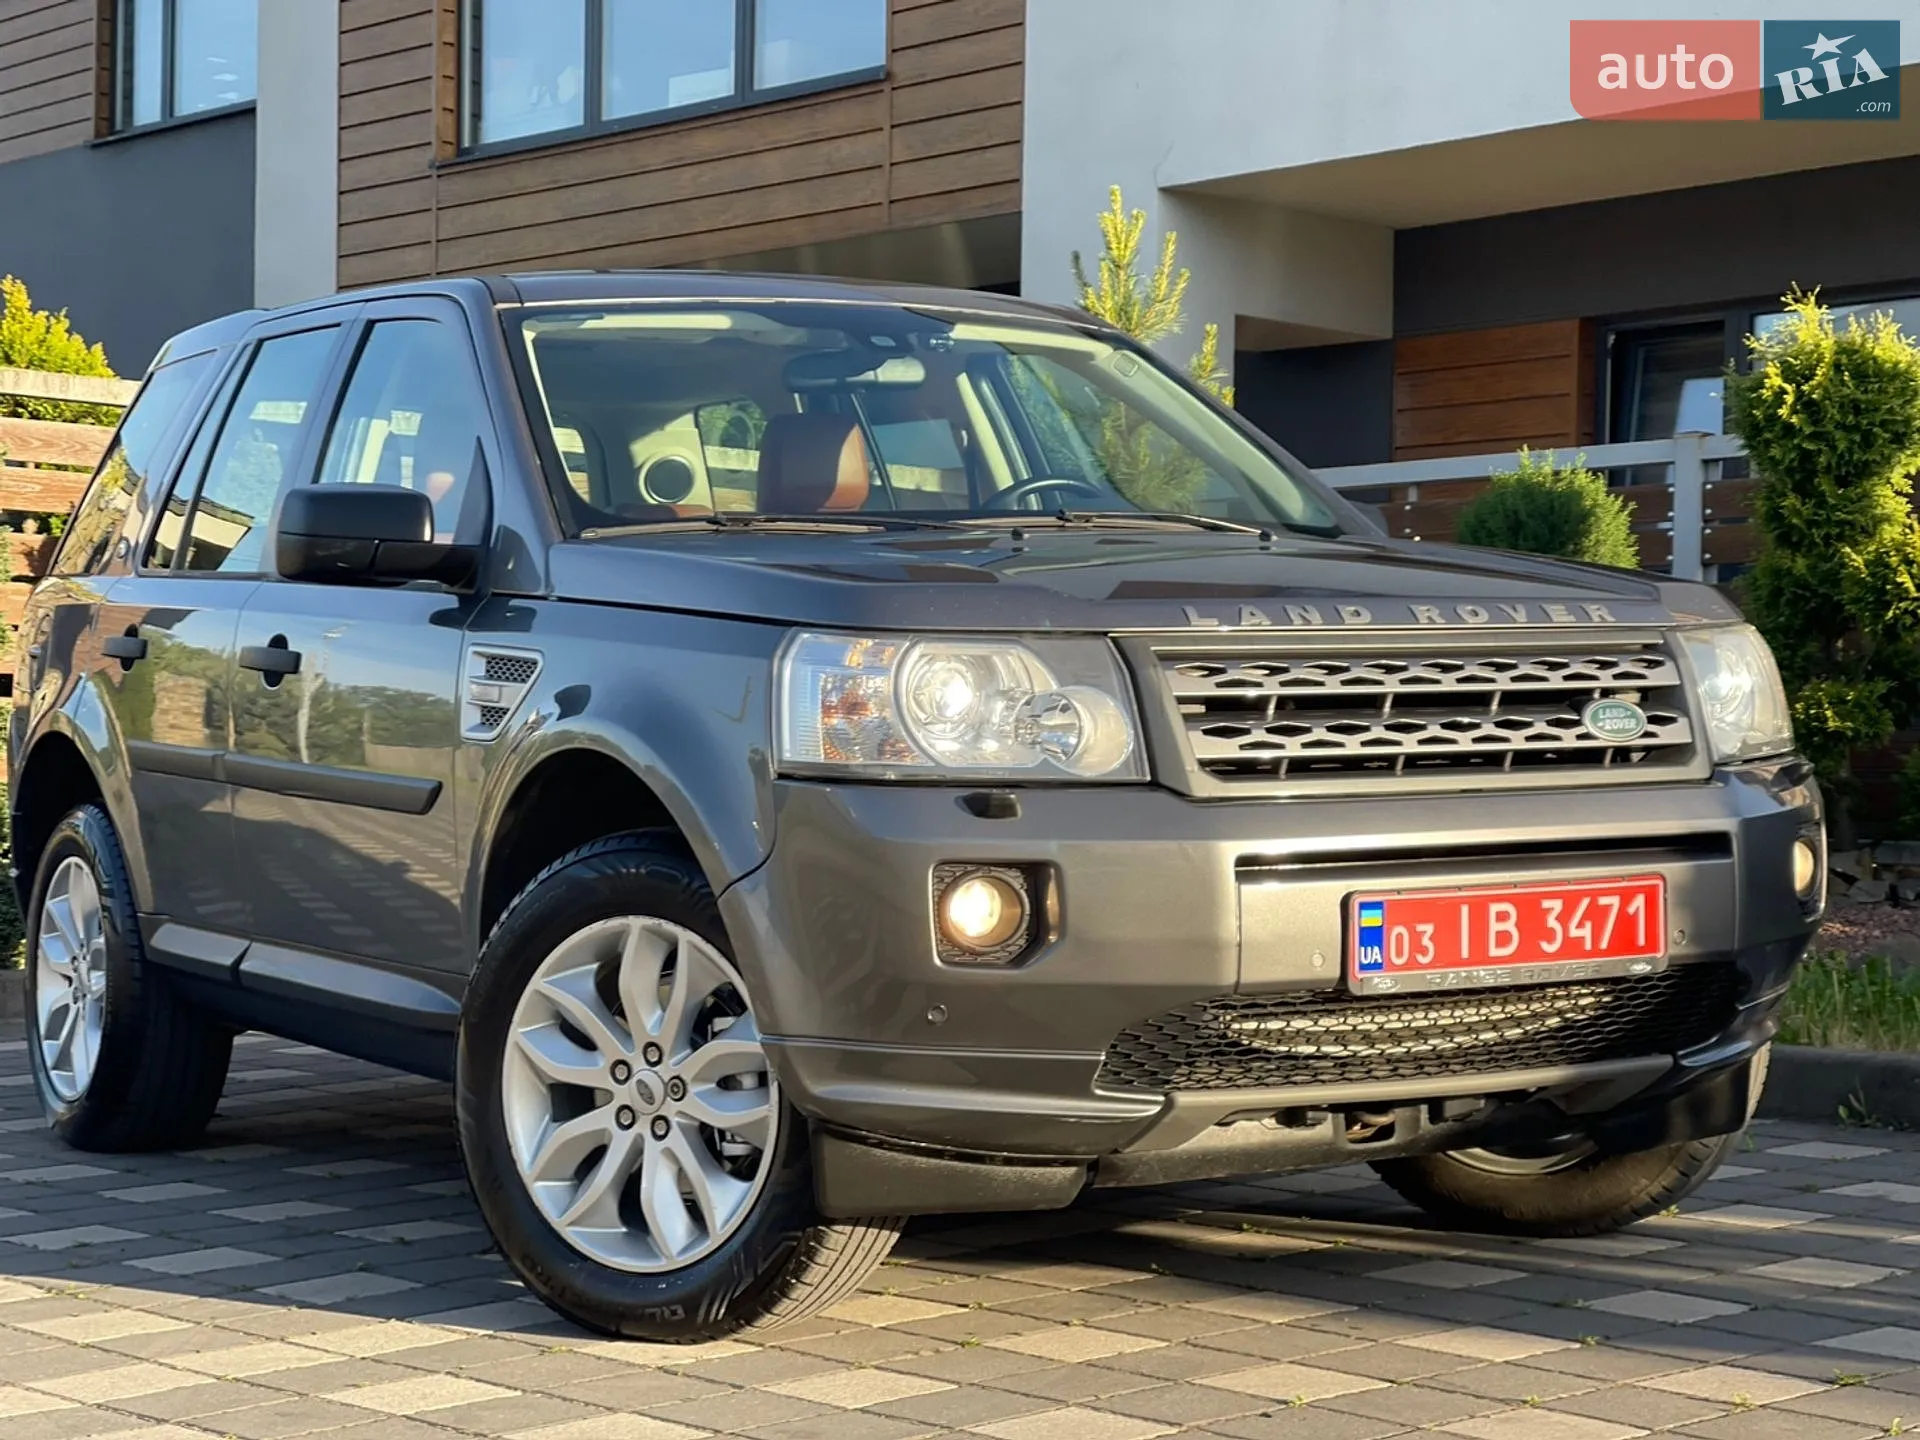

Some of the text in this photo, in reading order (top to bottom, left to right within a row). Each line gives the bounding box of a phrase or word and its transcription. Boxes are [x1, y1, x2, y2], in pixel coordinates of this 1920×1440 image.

[1184, 604, 1616, 627] LAND ROVER
[1389, 893, 1647, 966] 03 IB 3471
[1360, 945, 1382, 965] UA
